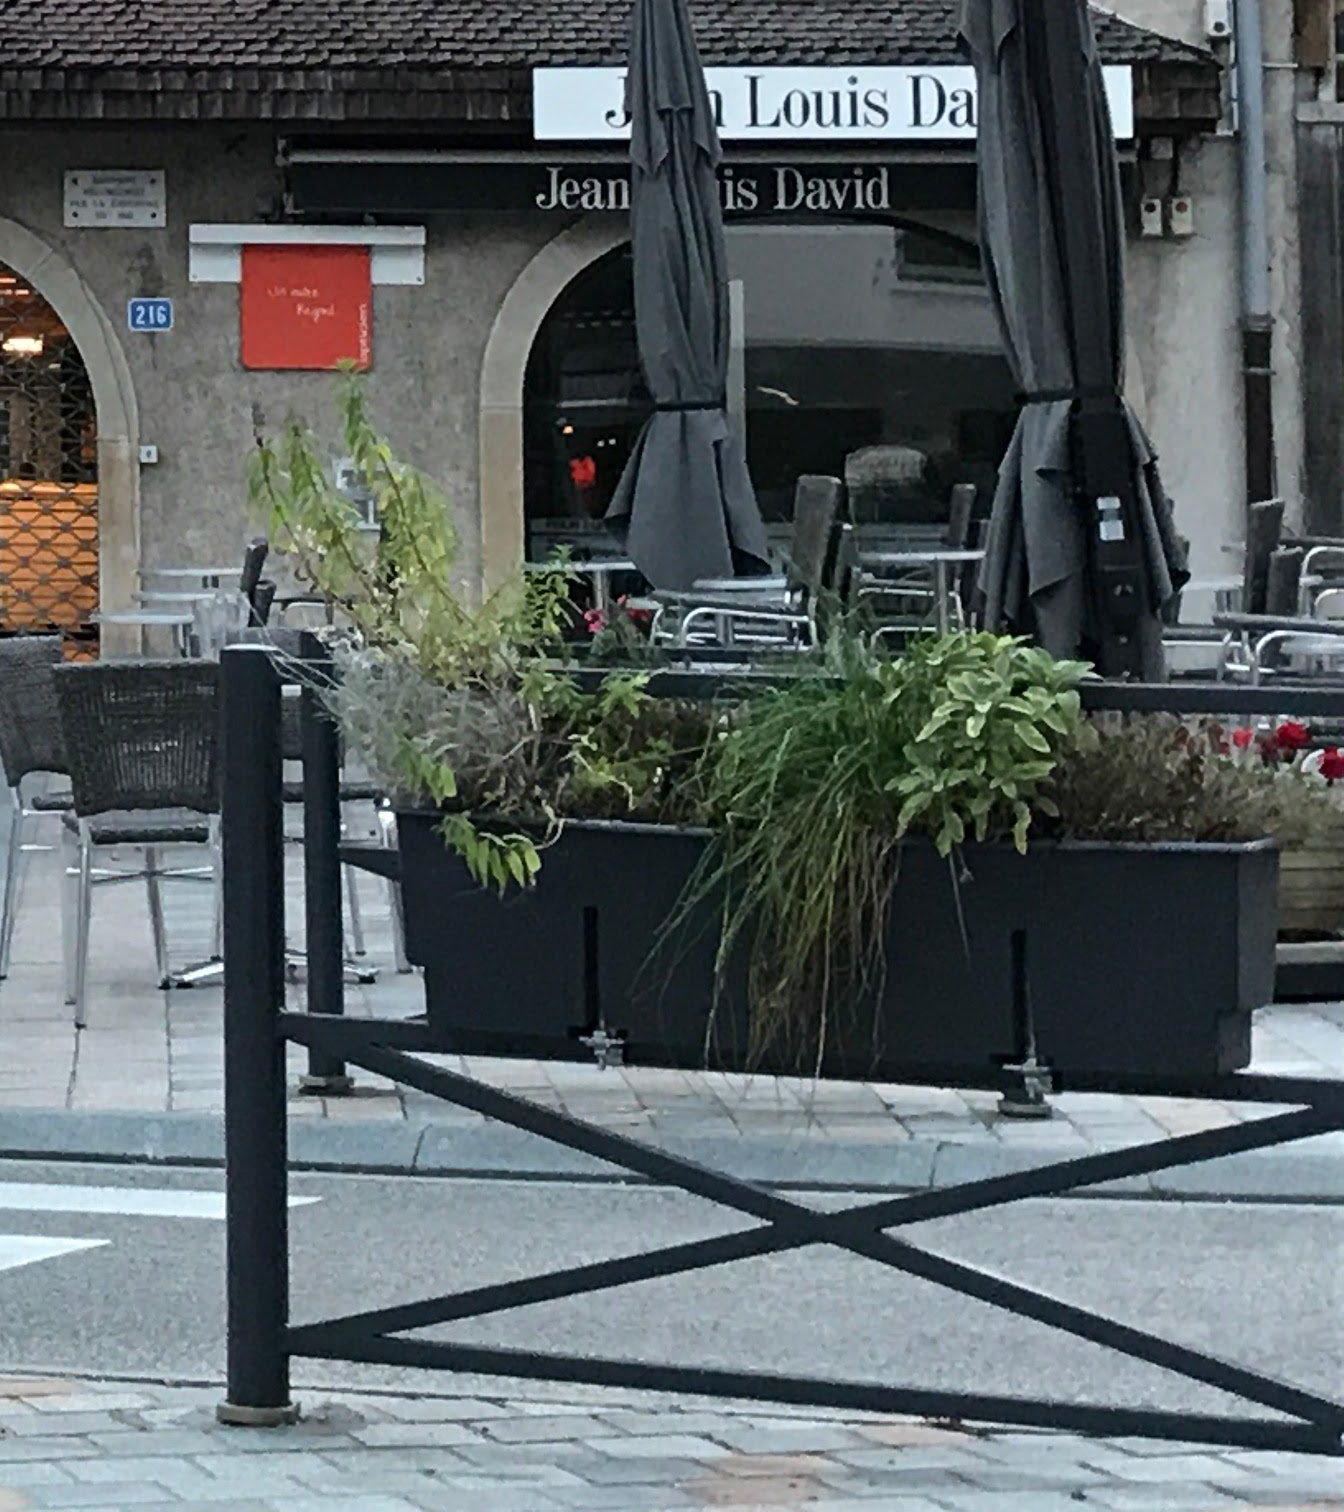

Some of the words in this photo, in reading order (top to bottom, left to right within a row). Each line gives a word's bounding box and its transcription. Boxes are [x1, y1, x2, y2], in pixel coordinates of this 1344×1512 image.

[604, 74, 726, 129] Jn
[744, 75, 890, 129] Louis
[535, 167, 630, 210] Jean
[773, 167, 889, 210] David
[136, 305, 167, 325] 216
